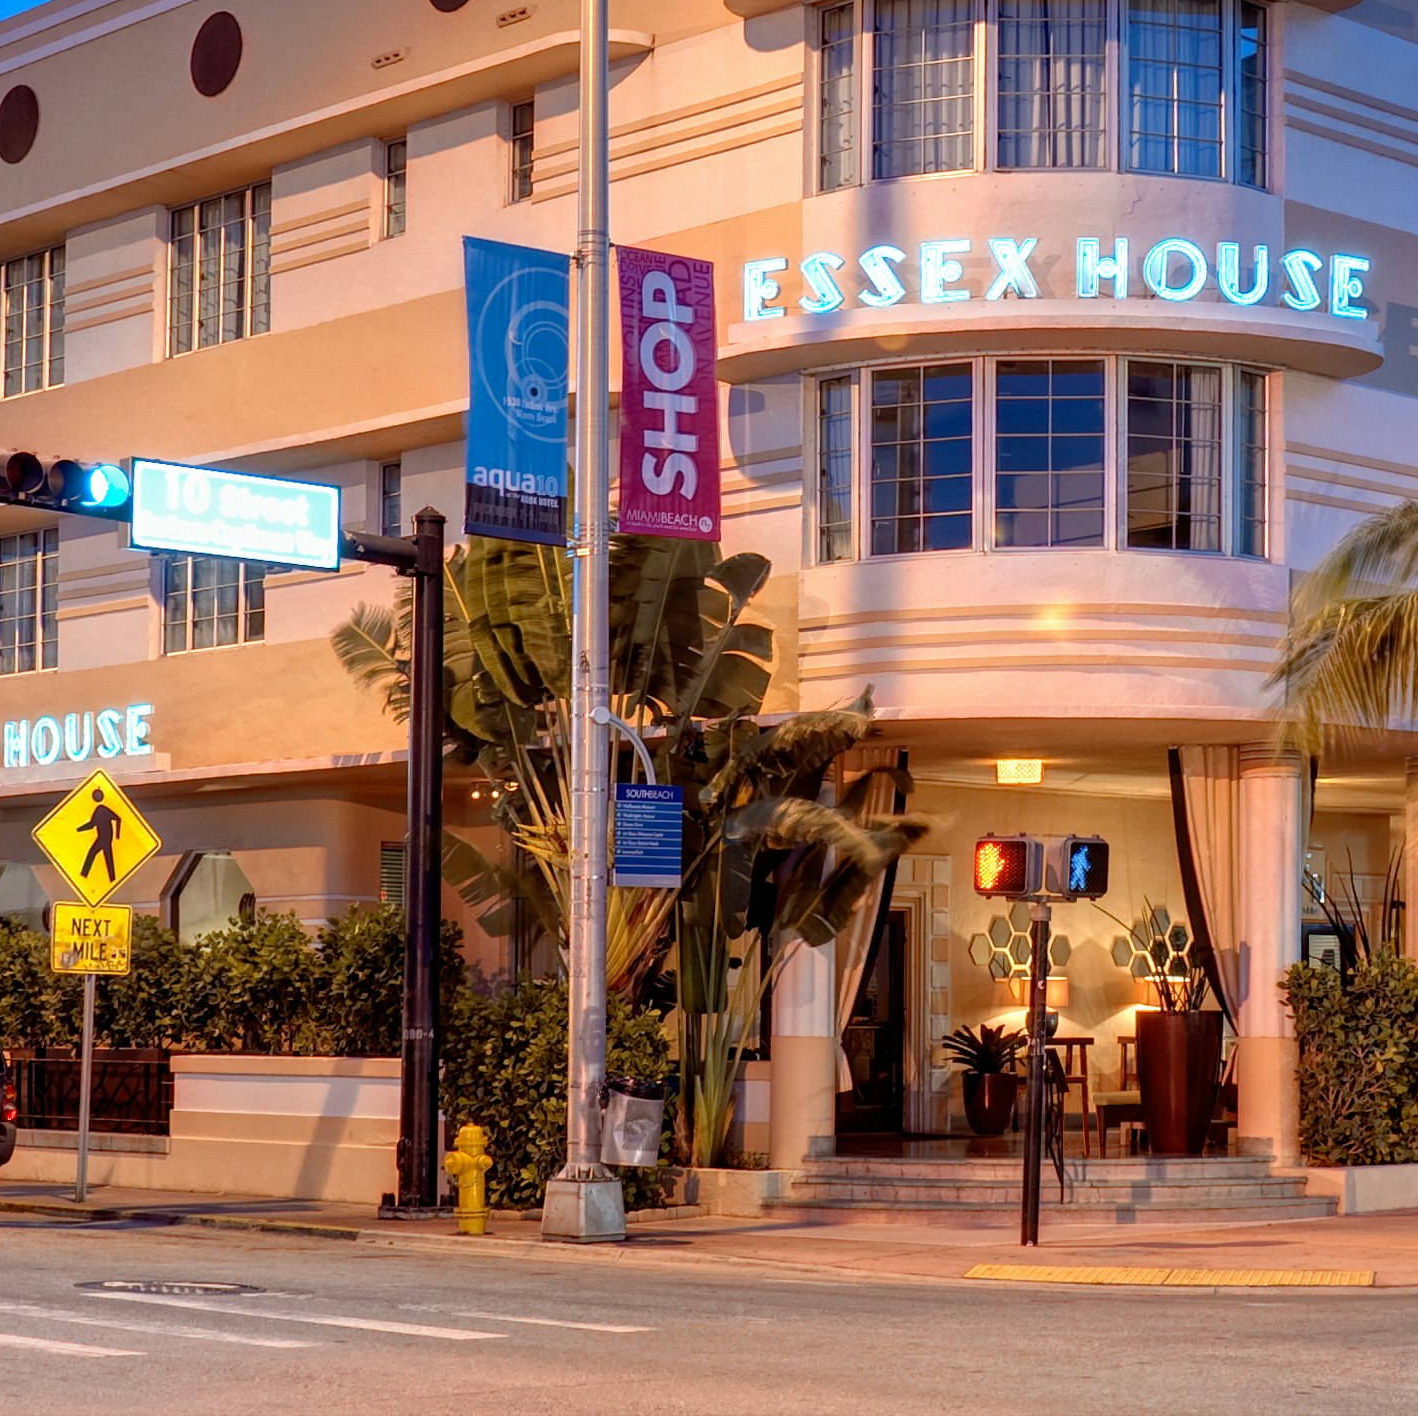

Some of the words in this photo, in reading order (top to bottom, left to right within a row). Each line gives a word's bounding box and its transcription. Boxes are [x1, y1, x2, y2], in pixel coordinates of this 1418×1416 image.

[742, 238, 1039, 322] ESSEX
[1074, 237, 1371, 320] HOUSE
[640, 270, 699, 501] SHOP
[165, 470, 212, 514] 10
[219, 484, 309, 527] Street
[3, 703, 154, 769] HOUSE
[71, 917, 111, 937] NEXT
[73, 941, 107, 961] MILE
